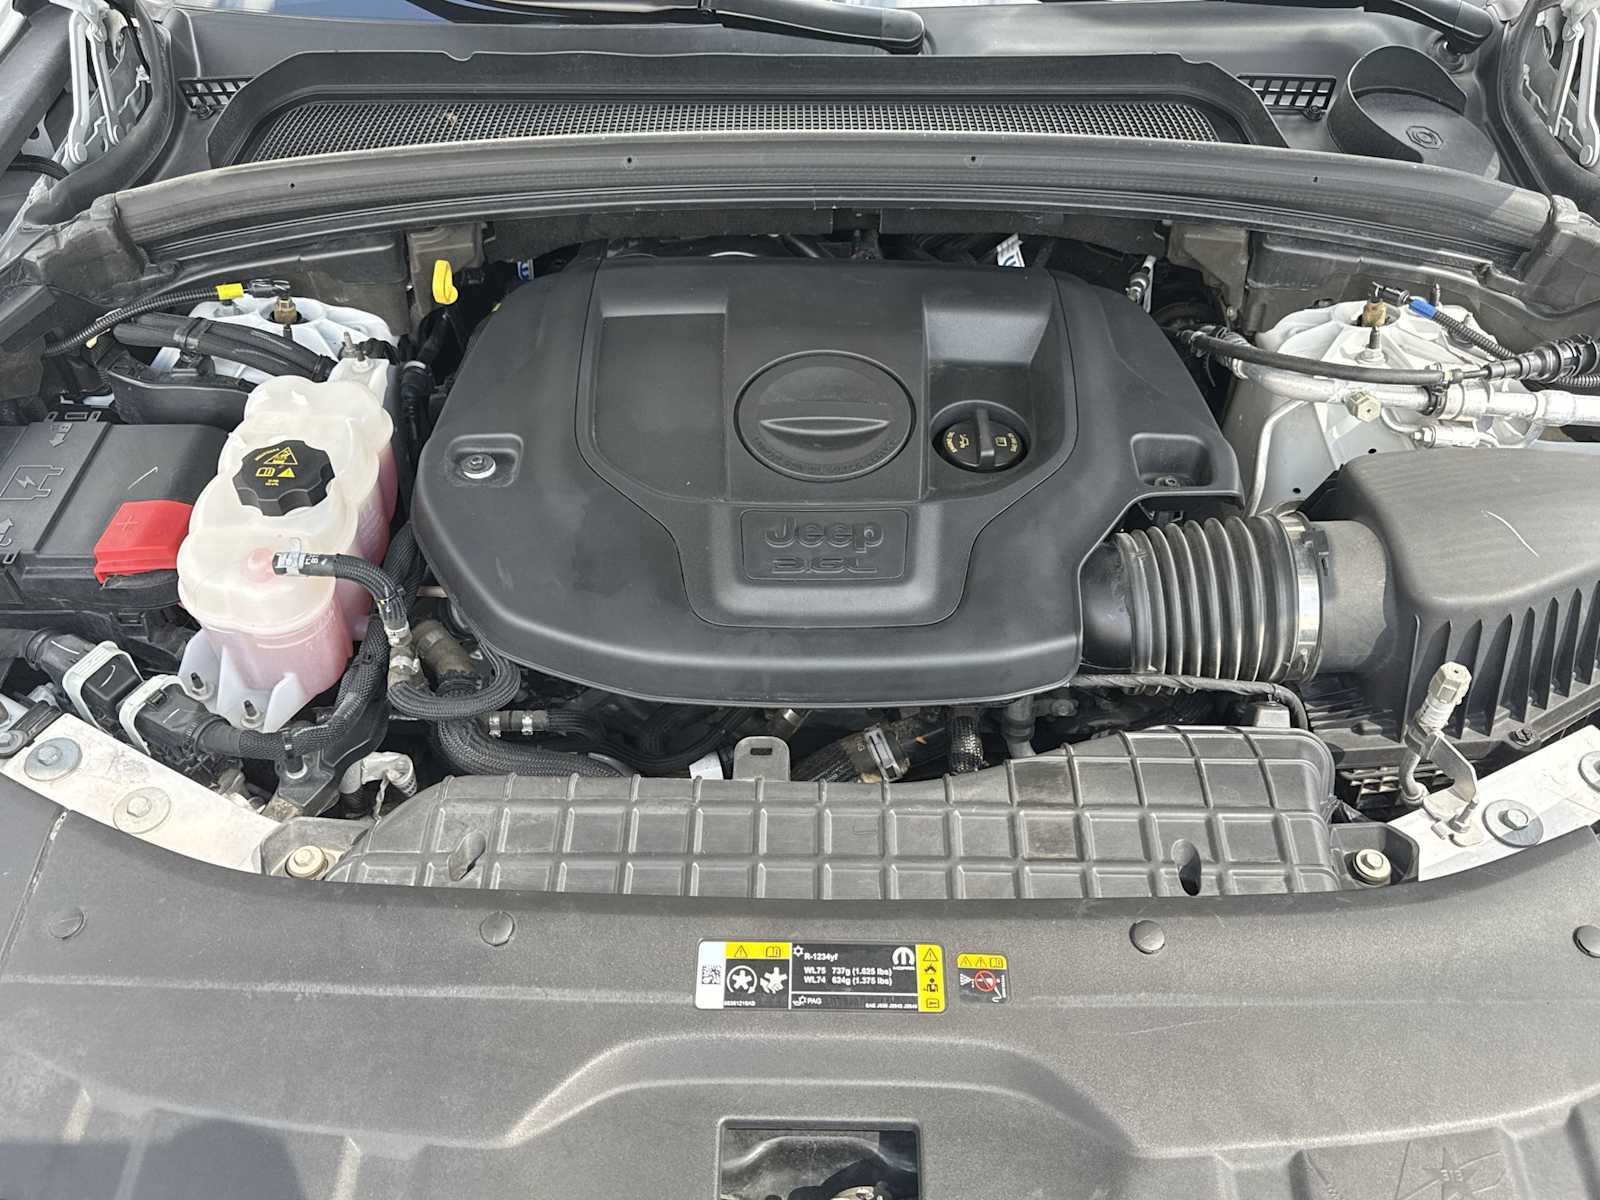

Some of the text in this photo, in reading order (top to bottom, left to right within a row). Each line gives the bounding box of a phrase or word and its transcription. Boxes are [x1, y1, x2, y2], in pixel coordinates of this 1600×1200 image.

[764, 517, 884, 553] Jeep
[771, 556, 878, 574] 3.6L
[803, 952, 839, 962] R-1234yf
[803, 966, 827, 975] WL75
[831, 966, 851, 976] 737g
[876, 967, 893, 977] lbs)
[803, 976, 827, 984] WL74
[876, 977, 893, 987] lbs)
[807, 997, 822, 1005] PAG
